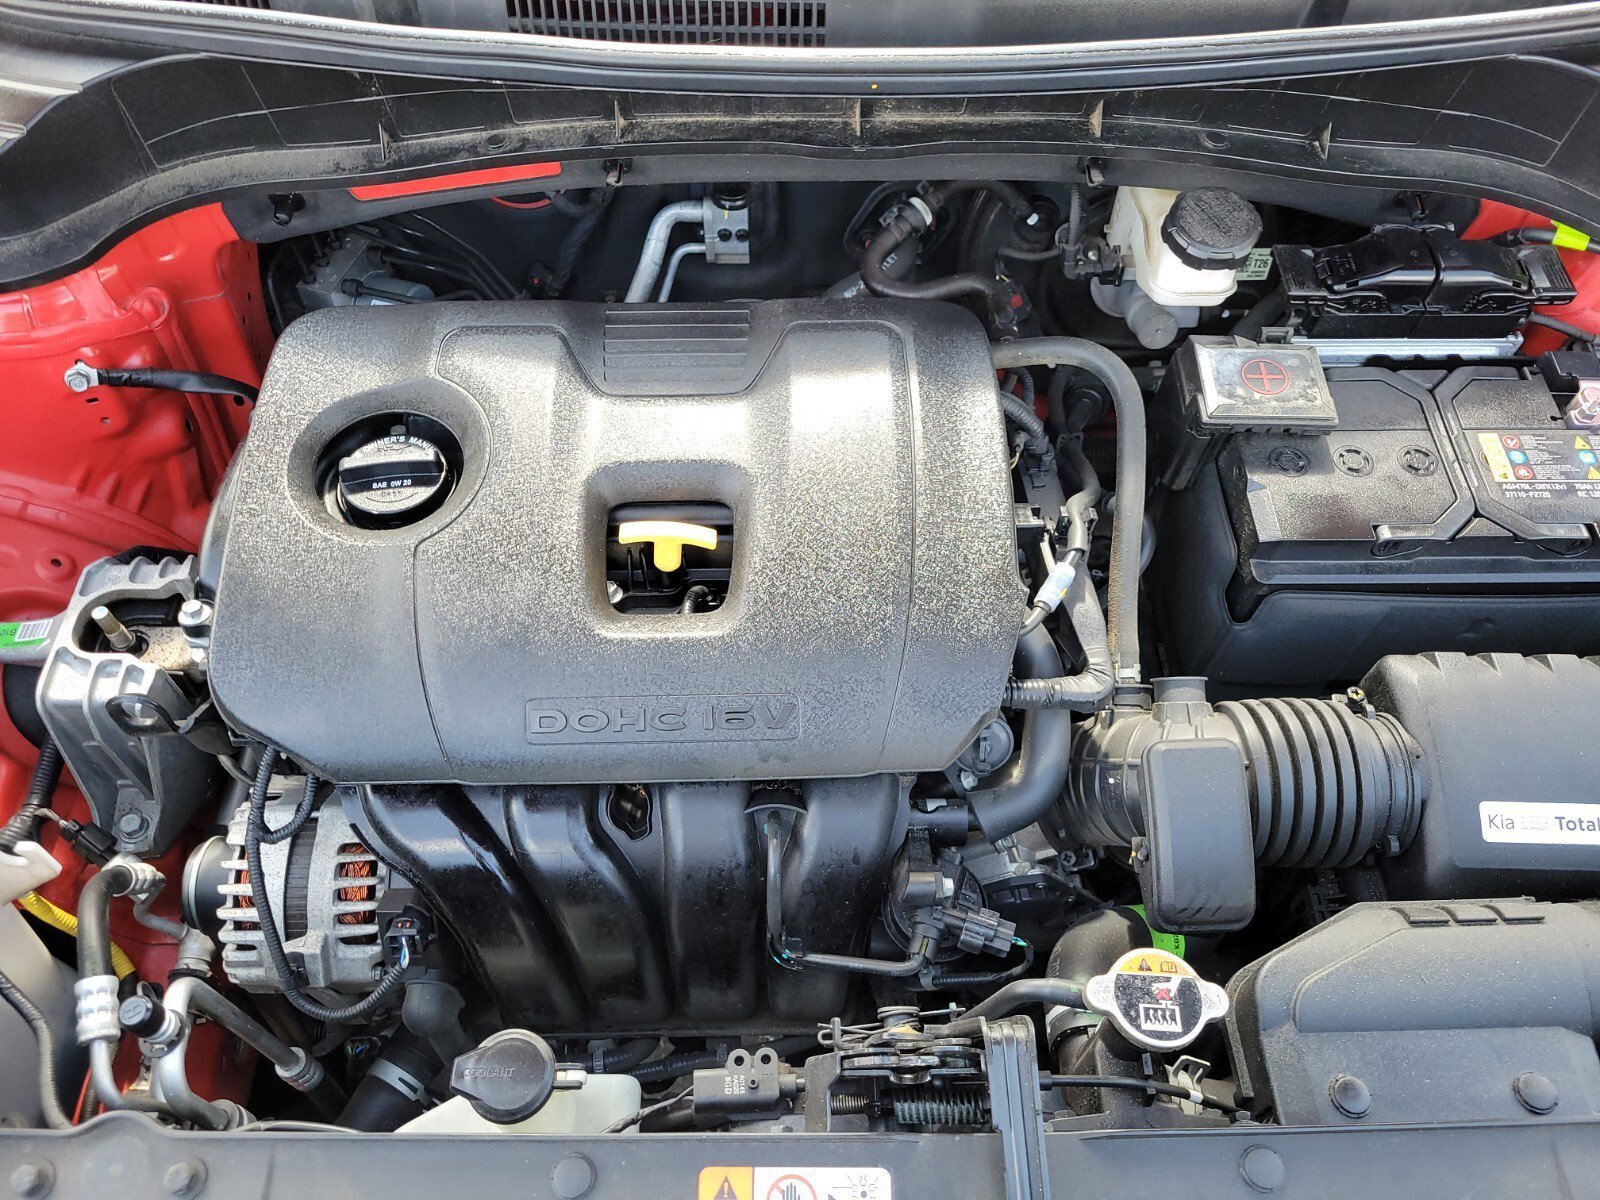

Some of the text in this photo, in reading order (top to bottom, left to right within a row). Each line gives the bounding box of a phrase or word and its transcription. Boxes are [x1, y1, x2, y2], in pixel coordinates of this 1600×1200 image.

[1253, 258, 1270, 269] T26
[530, 703, 798, 735] DOHC 16V
[1488, 813, 1515, 830] Kia
[463, 1067, 516, 1078] COOLANT
